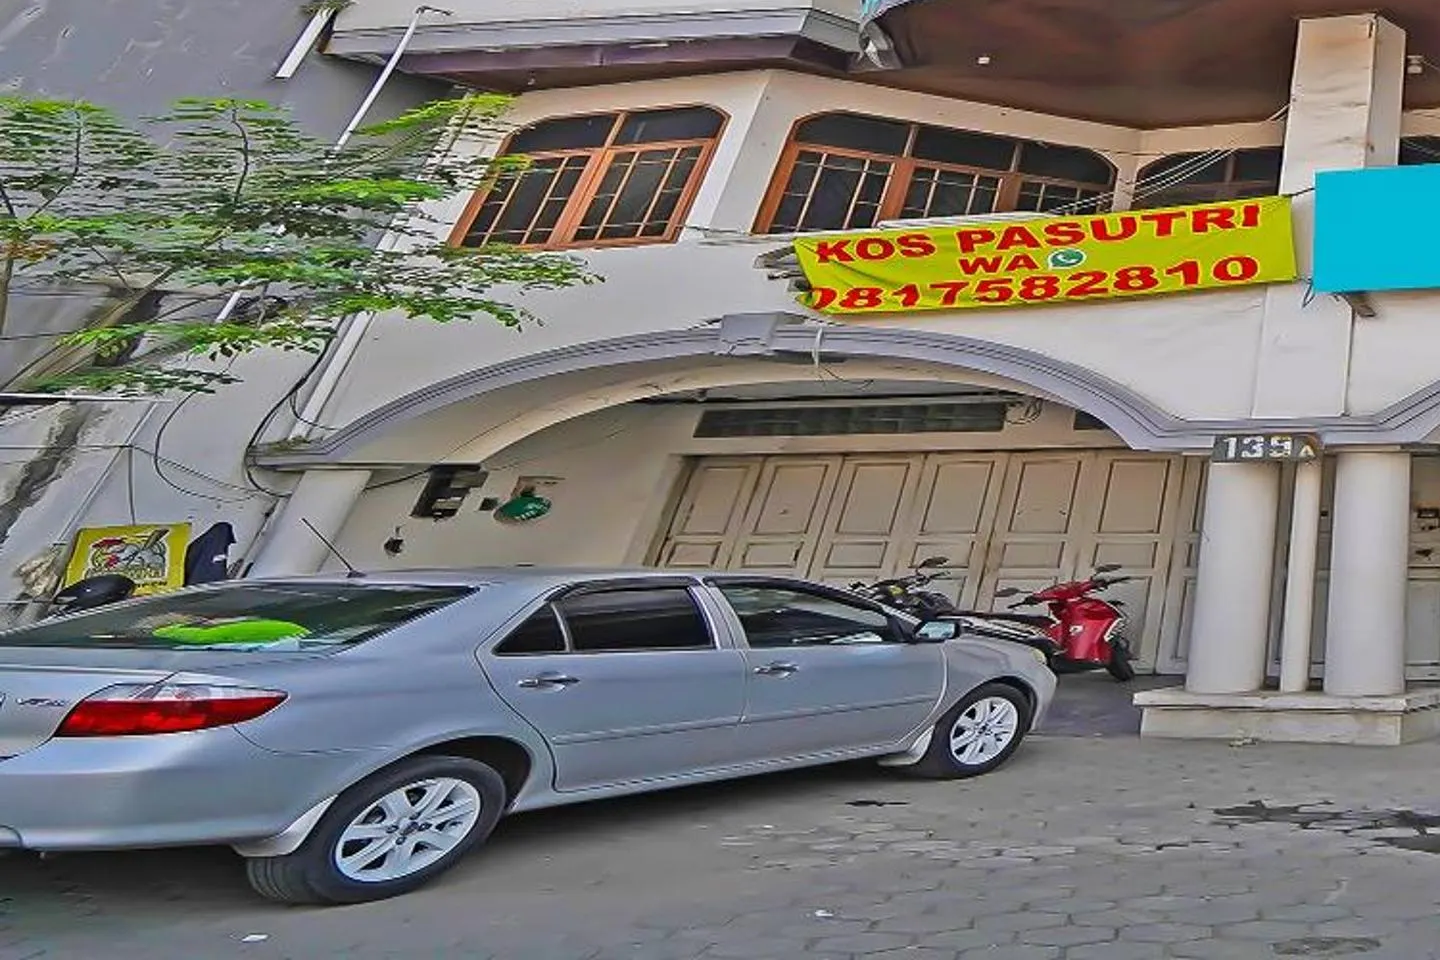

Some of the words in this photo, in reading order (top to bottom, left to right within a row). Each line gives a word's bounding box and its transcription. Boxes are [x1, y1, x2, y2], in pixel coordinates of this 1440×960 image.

[816, 233, 937, 264] KOS
[956, 204, 1261, 253] PASUTRI
[958, 252, 1039, 275] WA
